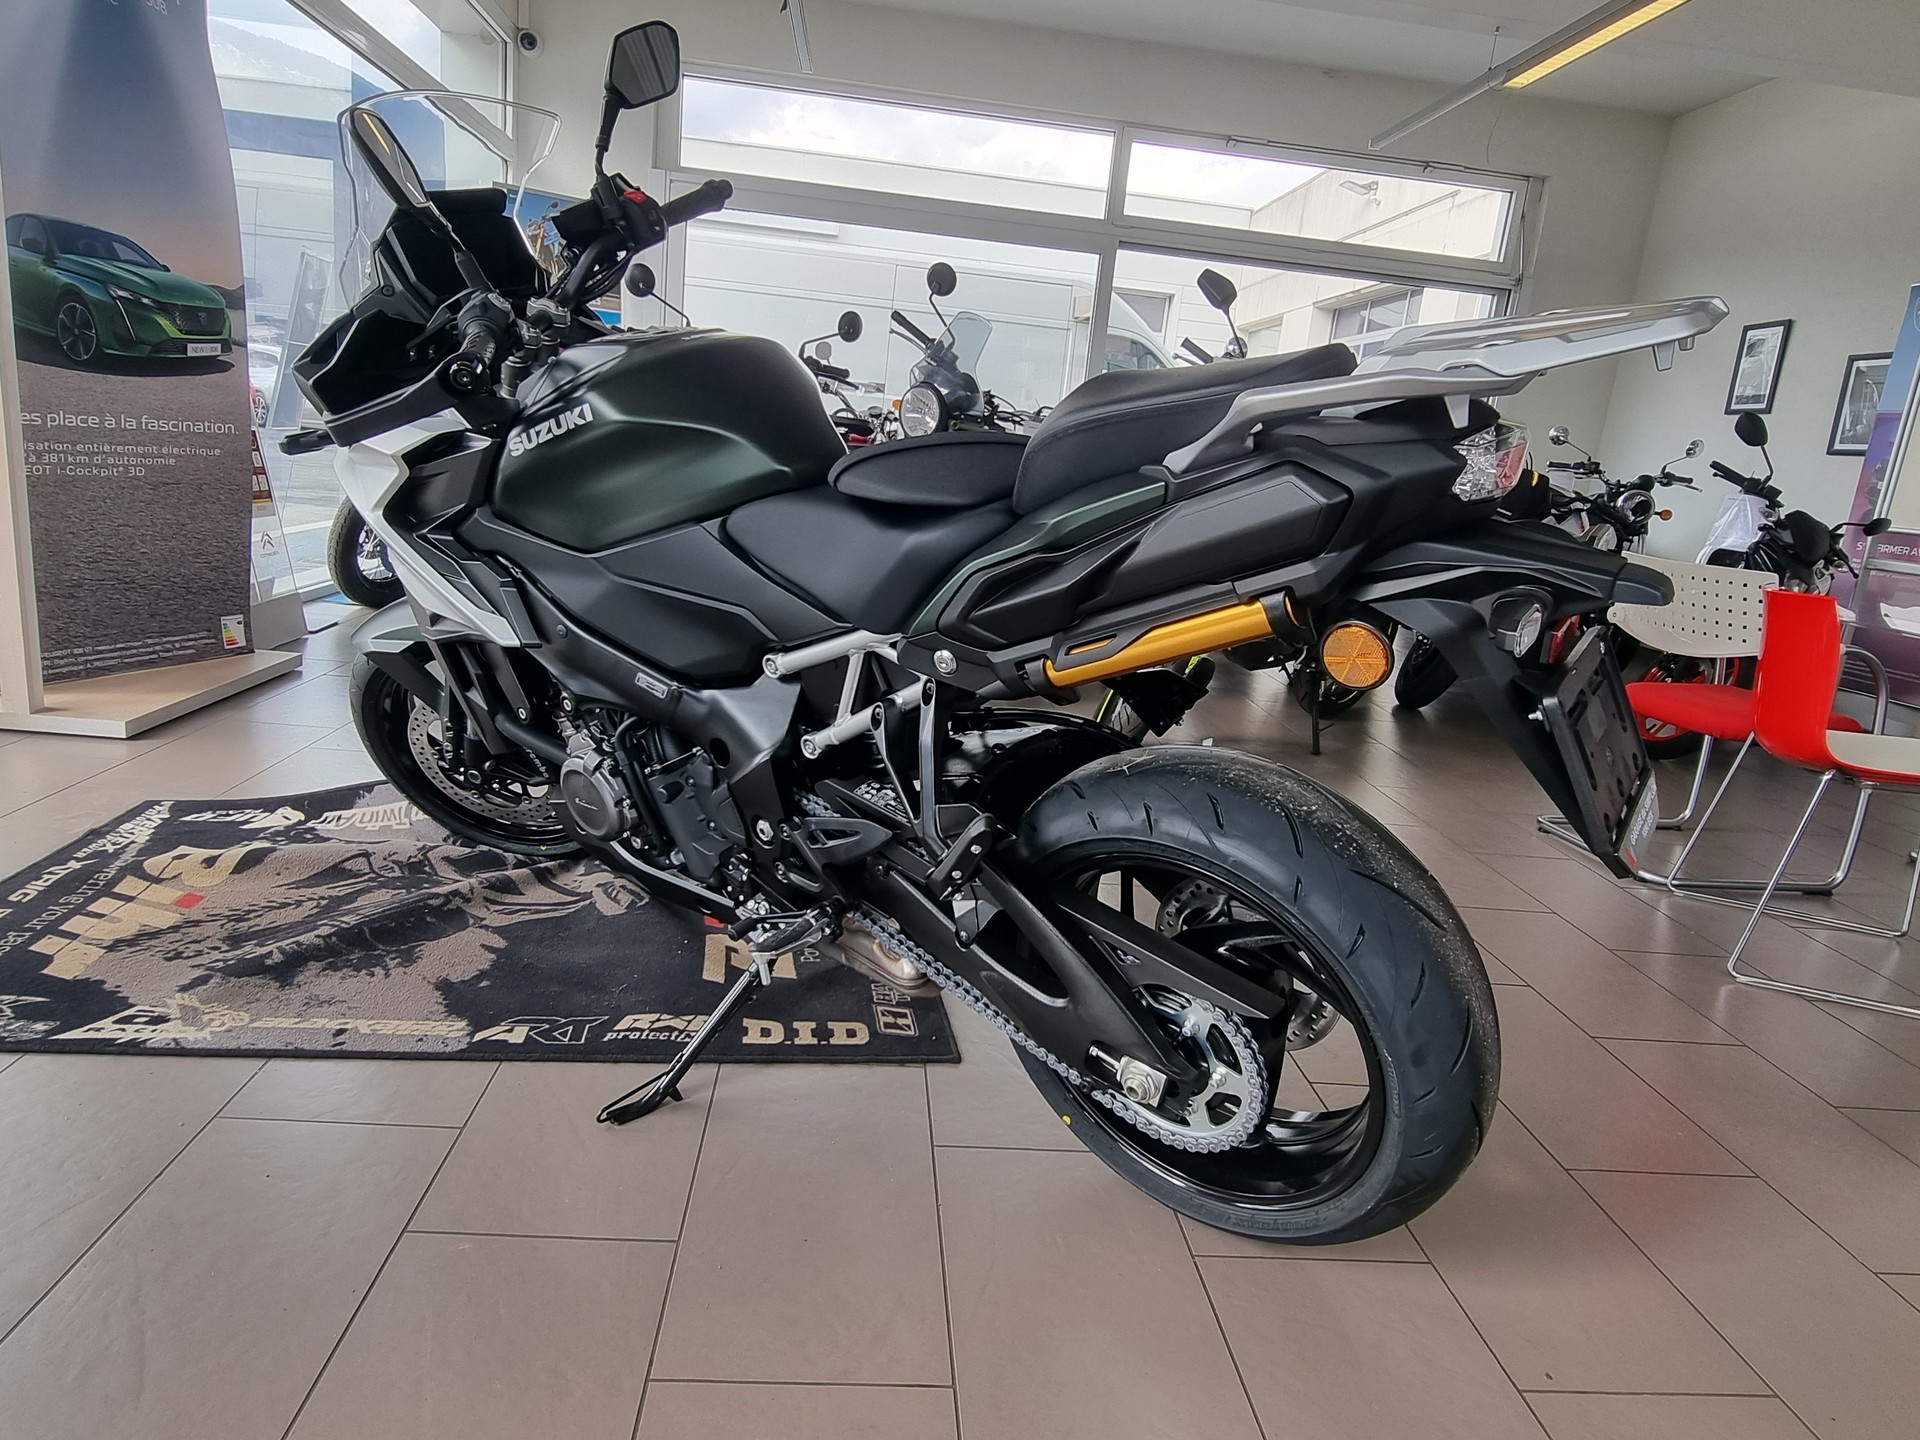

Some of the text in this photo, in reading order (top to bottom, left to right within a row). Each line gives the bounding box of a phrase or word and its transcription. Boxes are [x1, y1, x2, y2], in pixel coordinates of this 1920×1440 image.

[20, 410, 239, 434] es place à la fascination.
[509, 403, 594, 457] SUZUKI
[23, 440, 221, 456] isation entièrement électrique
[93, 454, 176, 466] d'autonomie
[128, 466, 145, 476] 3D
[23, 901, 75, 931] your
